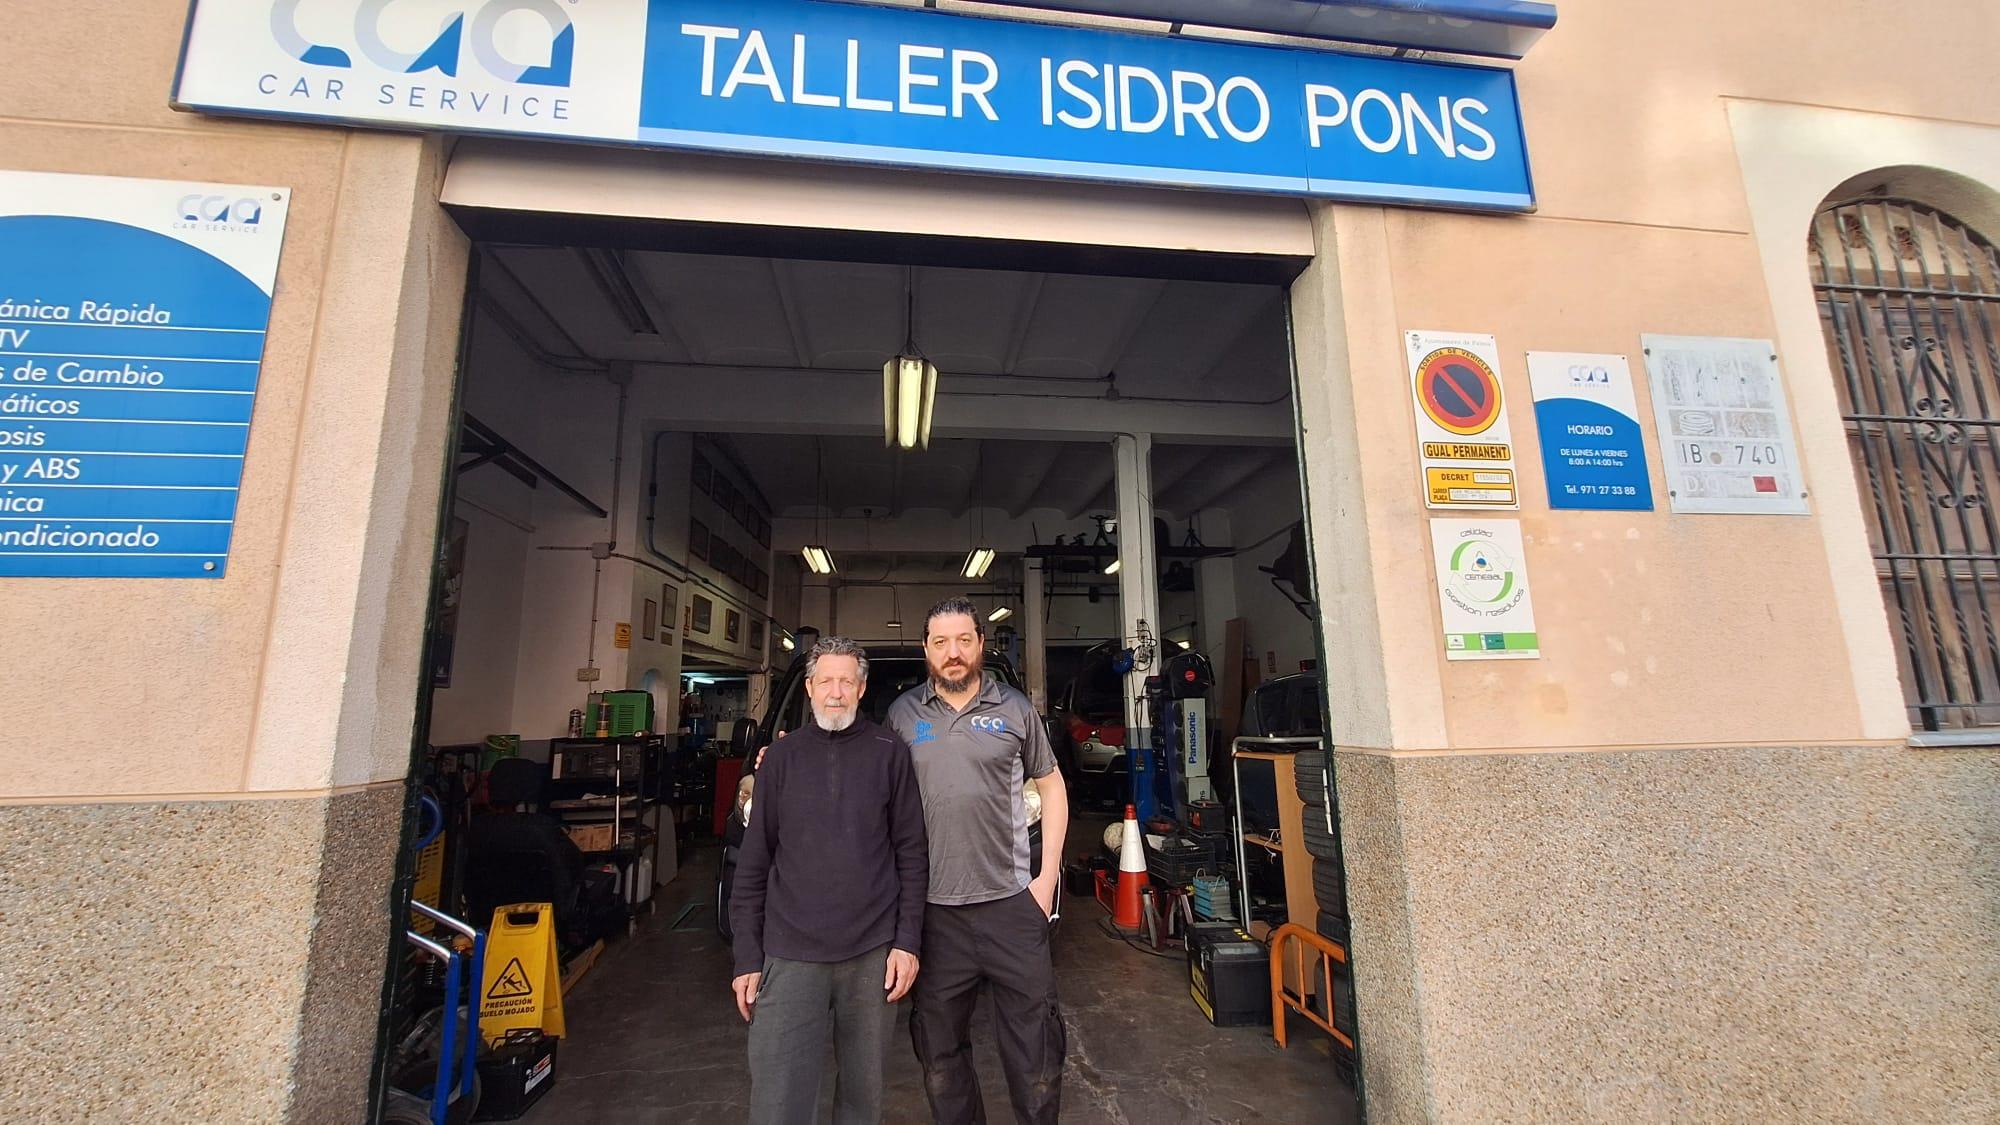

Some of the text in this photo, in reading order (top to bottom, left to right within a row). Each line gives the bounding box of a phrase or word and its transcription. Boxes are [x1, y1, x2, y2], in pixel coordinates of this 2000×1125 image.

[258, 73, 571, 121] CAR SERVICE
[681, 23, 1497, 161] TALLER ISIDRO PONS
[173, 222, 258, 234] CAR SERVICE
[79, 301, 171, 326] Rápida
[13, 360, 48, 382] de
[57, 361, 165, 386] Cambio
[0, 392, 80, 416] áticos
[1567, 425, 1614, 436] HORARIO
[1426, 444, 1508, 459] GUAL PERMANENT
[1568, 458, 1585, 466] 8:00
[1592, 458, 1612, 467] 14:00
[1570, 449, 1594, 457] LUNES
[1600, 450, 1628, 458] VIERNES
[1681, 443, 1776, 466] IB 740
[1, 457, 81, 483] y ABS
[1441, 473, 1469, 481] DECRET
[0, 490, 45, 512] ica
[1565, 484, 1636, 496] Tel. 971 27 33 88
[0, 523, 160, 548] ndicionado
[1188, 711, 1197, 764] Panasonic
[485, 998, 533, 1009] PRECAUCIÓN
[504, 1006, 536, 1016] MOJADO
